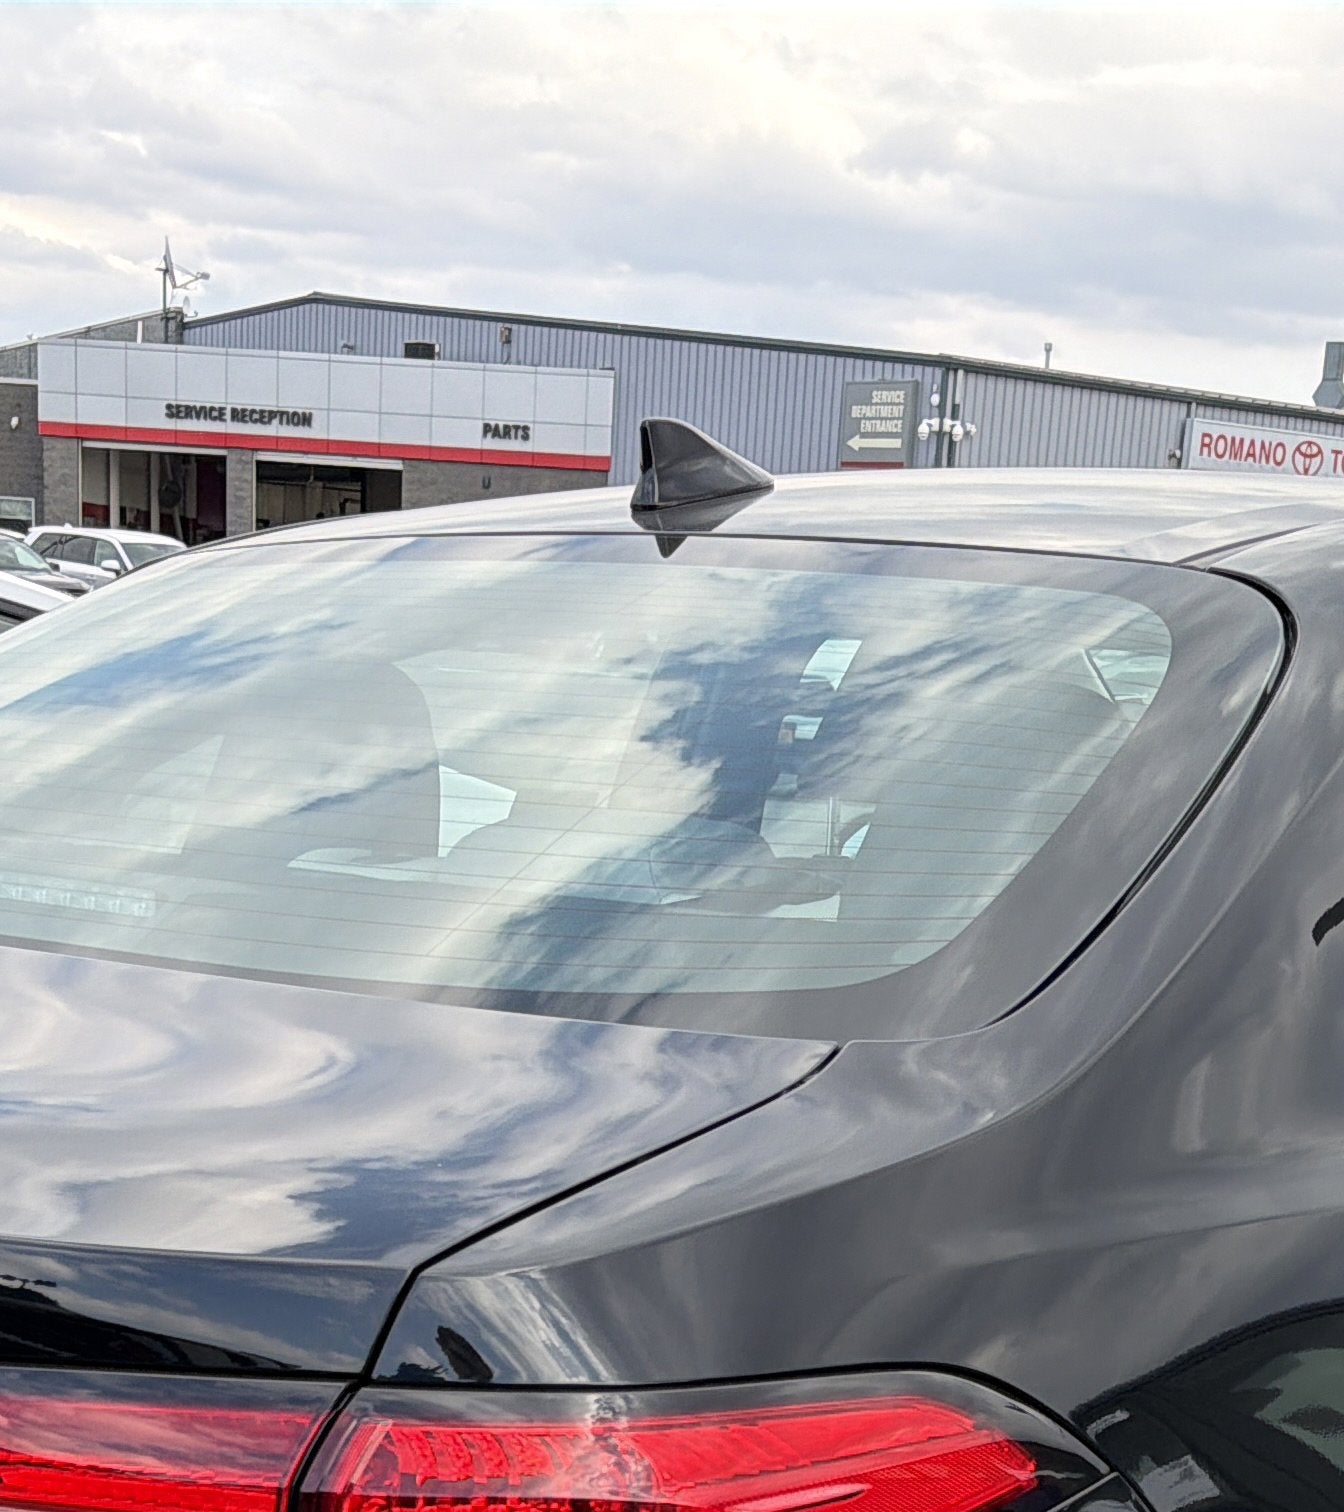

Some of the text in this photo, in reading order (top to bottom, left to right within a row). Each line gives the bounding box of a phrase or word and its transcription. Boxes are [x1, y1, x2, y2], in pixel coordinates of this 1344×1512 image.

[871, 390, 905, 404] SERVICE
[165, 403, 312, 428] SERVICE RECEPTION
[851, 405, 904, 418] DEPARTMENT
[482, 422, 531, 442] PARTS
[860, 420, 903, 433] ENTRANCE
[1199, 432, 1287, 468] ROMANO
